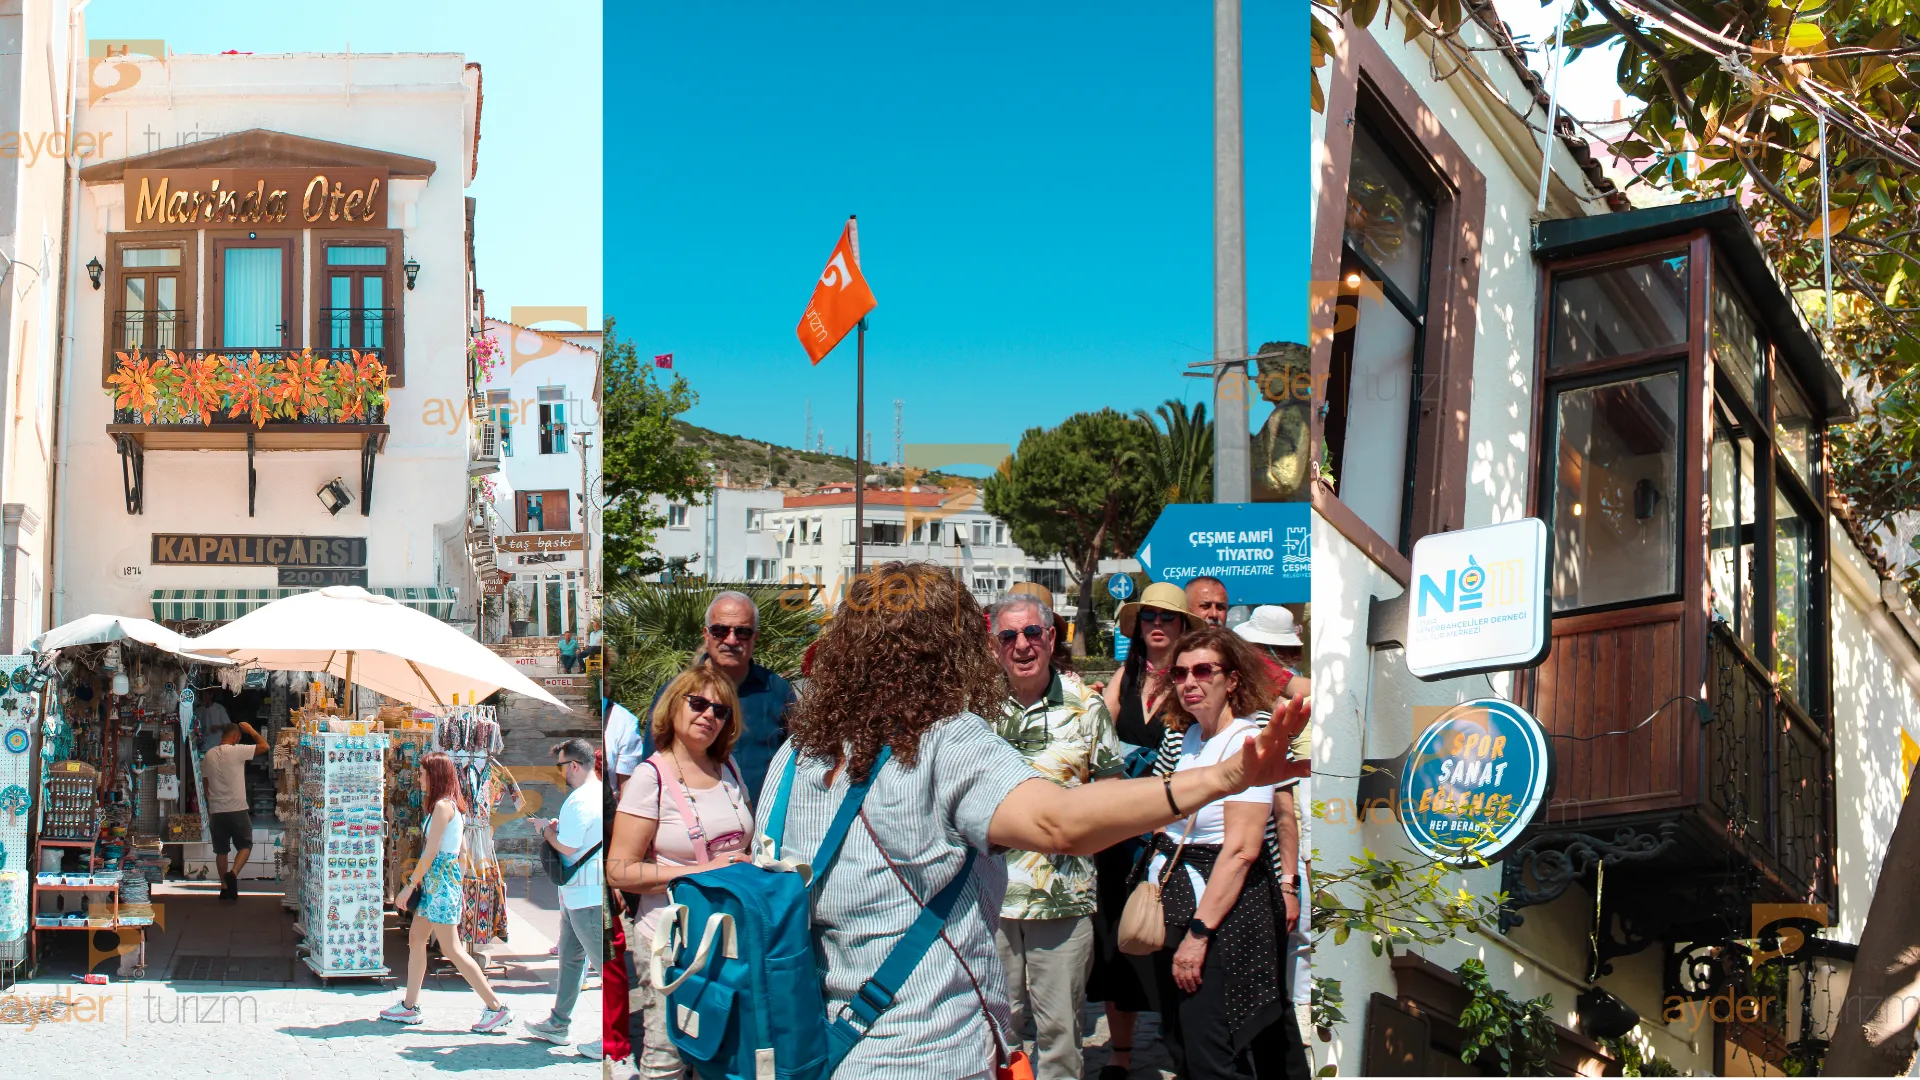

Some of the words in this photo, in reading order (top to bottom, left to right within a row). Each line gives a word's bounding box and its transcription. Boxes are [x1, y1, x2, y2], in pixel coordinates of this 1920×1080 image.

[135, 177, 288, 224] Marinda
[302, 175, 381, 223] Otel
[1189, 531, 1235, 547] ÇEŞME
[1238, 528, 1273, 543] AMFİ
[1216, 546, 1274, 561] TİYATRO
[1163, 566, 1196, 580] ÇEŞME
[1198, 565, 1275, 577] AMPHITHEATRE
[1282, 563, 1311, 573] ÇEŞME
[283, 571, 324, 584] 200
[1490, 610, 1527, 624] DERNEĞİ
[520, 658, 539, 666] OTEL
[1450, 733, 1507, 760] SPOR
[1438, 759, 1508, 787] SANAT
[1418, 785, 1513, 819] EĞLENCE
[1429, 819, 1449, 832] HEP
[1450, 820, 1493, 833] BERAB
